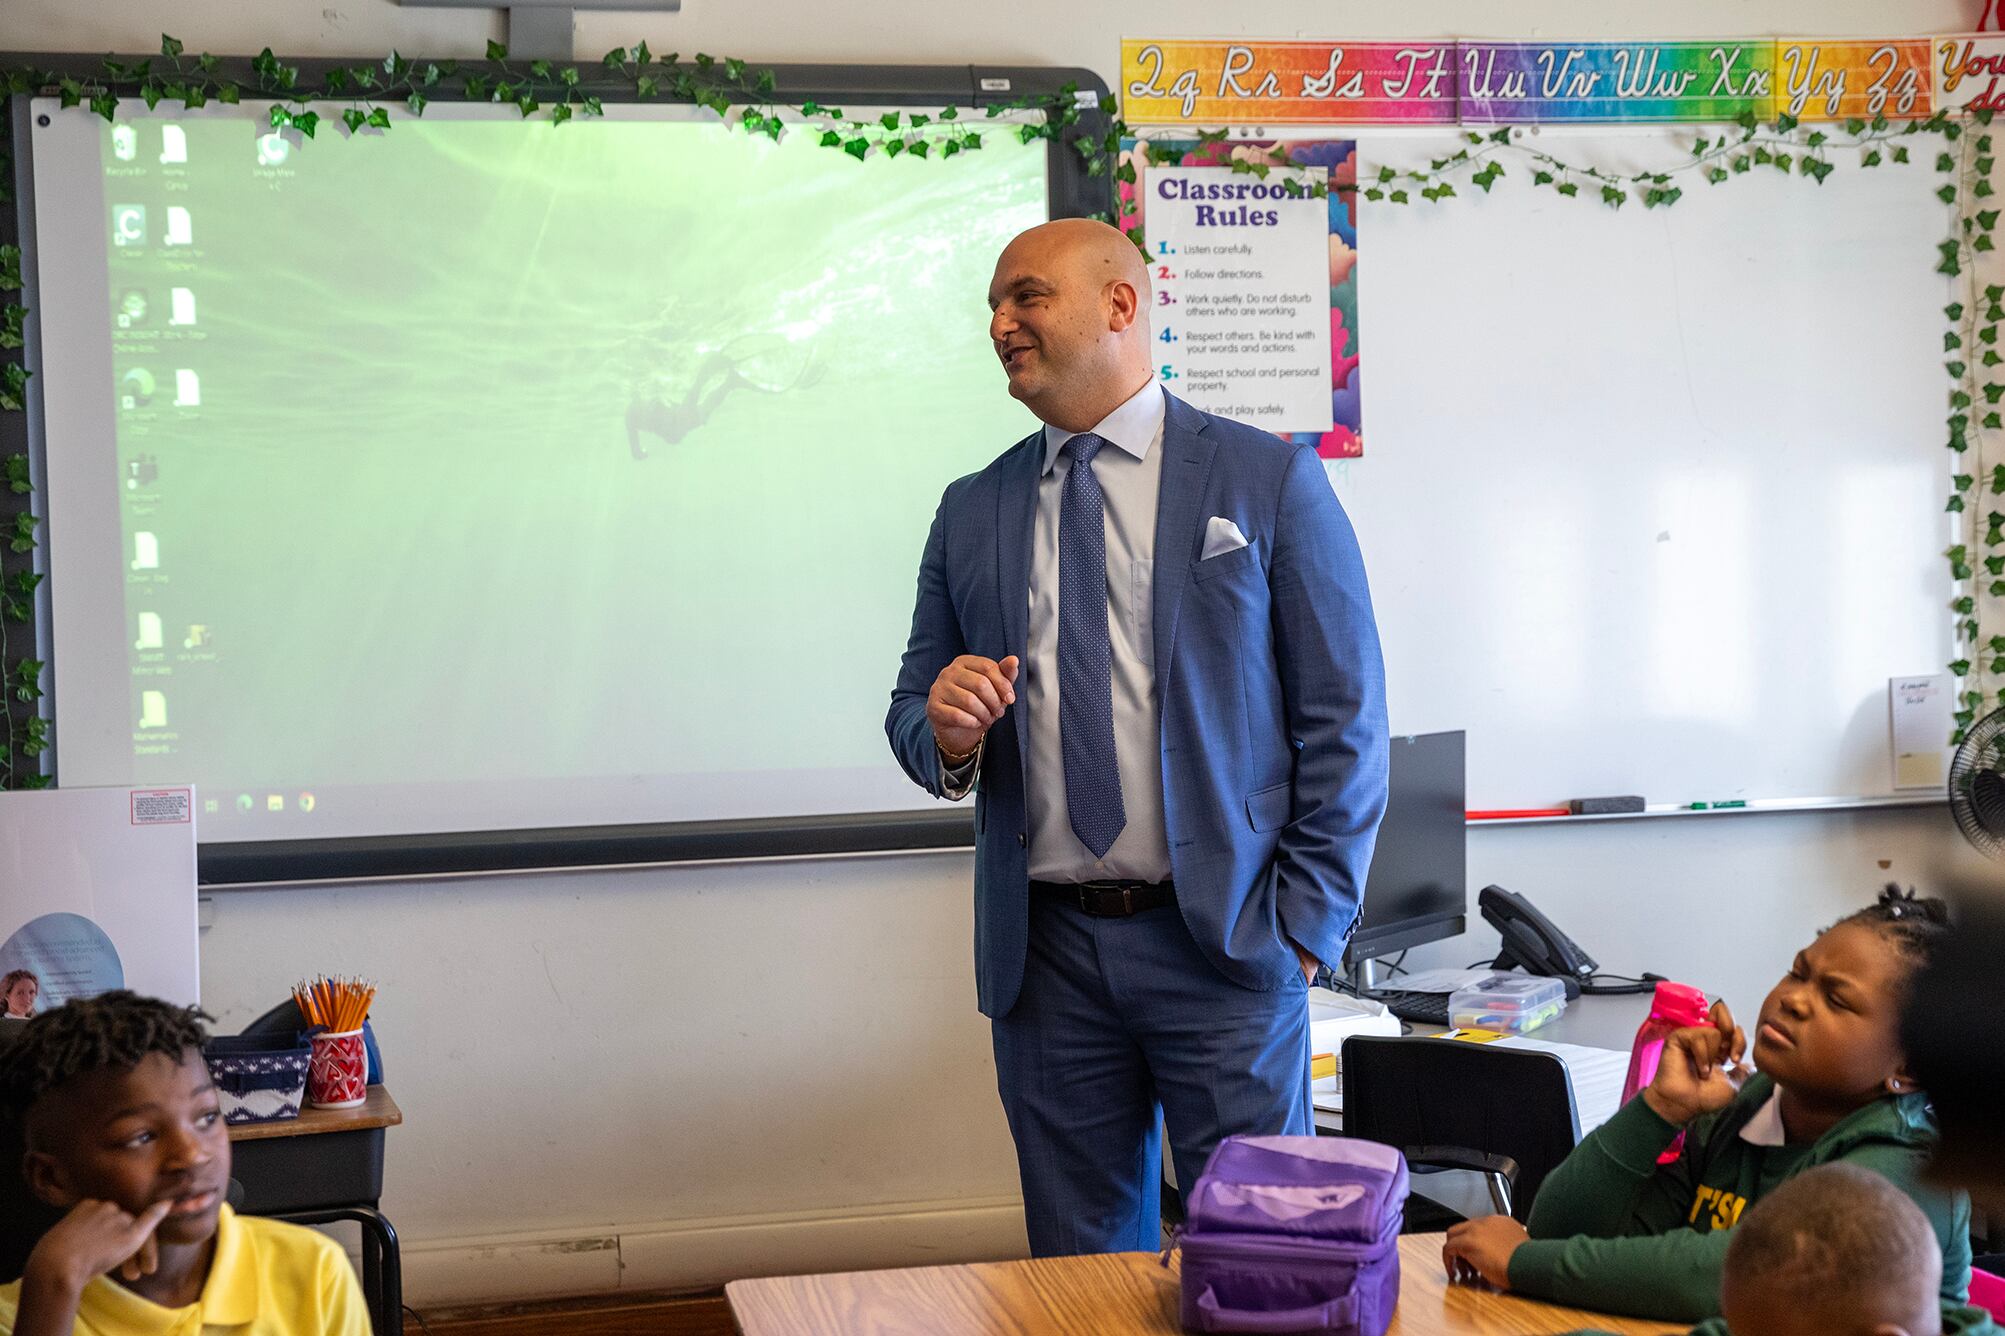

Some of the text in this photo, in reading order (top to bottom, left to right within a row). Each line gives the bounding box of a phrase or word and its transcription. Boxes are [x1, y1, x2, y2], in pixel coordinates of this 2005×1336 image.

[1218, 46, 1281, 98] Rr
[1300, 48, 1366, 99] Ss
[1382, 48, 1449, 99] Tt
[1464, 47, 1527, 99] Uu
[1536, 47, 1601, 98] Vv
[1613, 47, 1697, 98] Ww
[1709, 46, 1771, 98] Xx
[1783, 46, 1847, 117] Yy
[1866, 46, 1920, 115] Zz
[1195, 204, 1279, 226] Rules
[1158, 241, 1177, 255] 1.
[1184, 243, 1211, 255] Listen
[1158, 266, 1263, 280] 2. Follow directions.
[1158, 290, 1178, 306] 3.
[1185, 294, 1210, 304] Work
[1247, 293, 1261, 304] Do
[1262, 294, 1278, 304] not
[1279, 293, 1312, 304] disturb
[1186, 306, 1297, 318] others who are working.
[1159, 327, 1178, 343] 4.
[1186, 331, 1223, 343] Respect
[1259, 331, 1271, 341] Be
[1273, 331, 1294, 341] kind
[1295, 331, 1316, 341] with
[1186, 344, 1210, 355] your
[1211, 342, 1239, 353] words
[1241, 342, 1260, 353] and
[1160, 365, 1320, 380] 5. Respect school and personal
[1215, 404, 1234, 415] and
[1235, 404, 1256, 416] play
